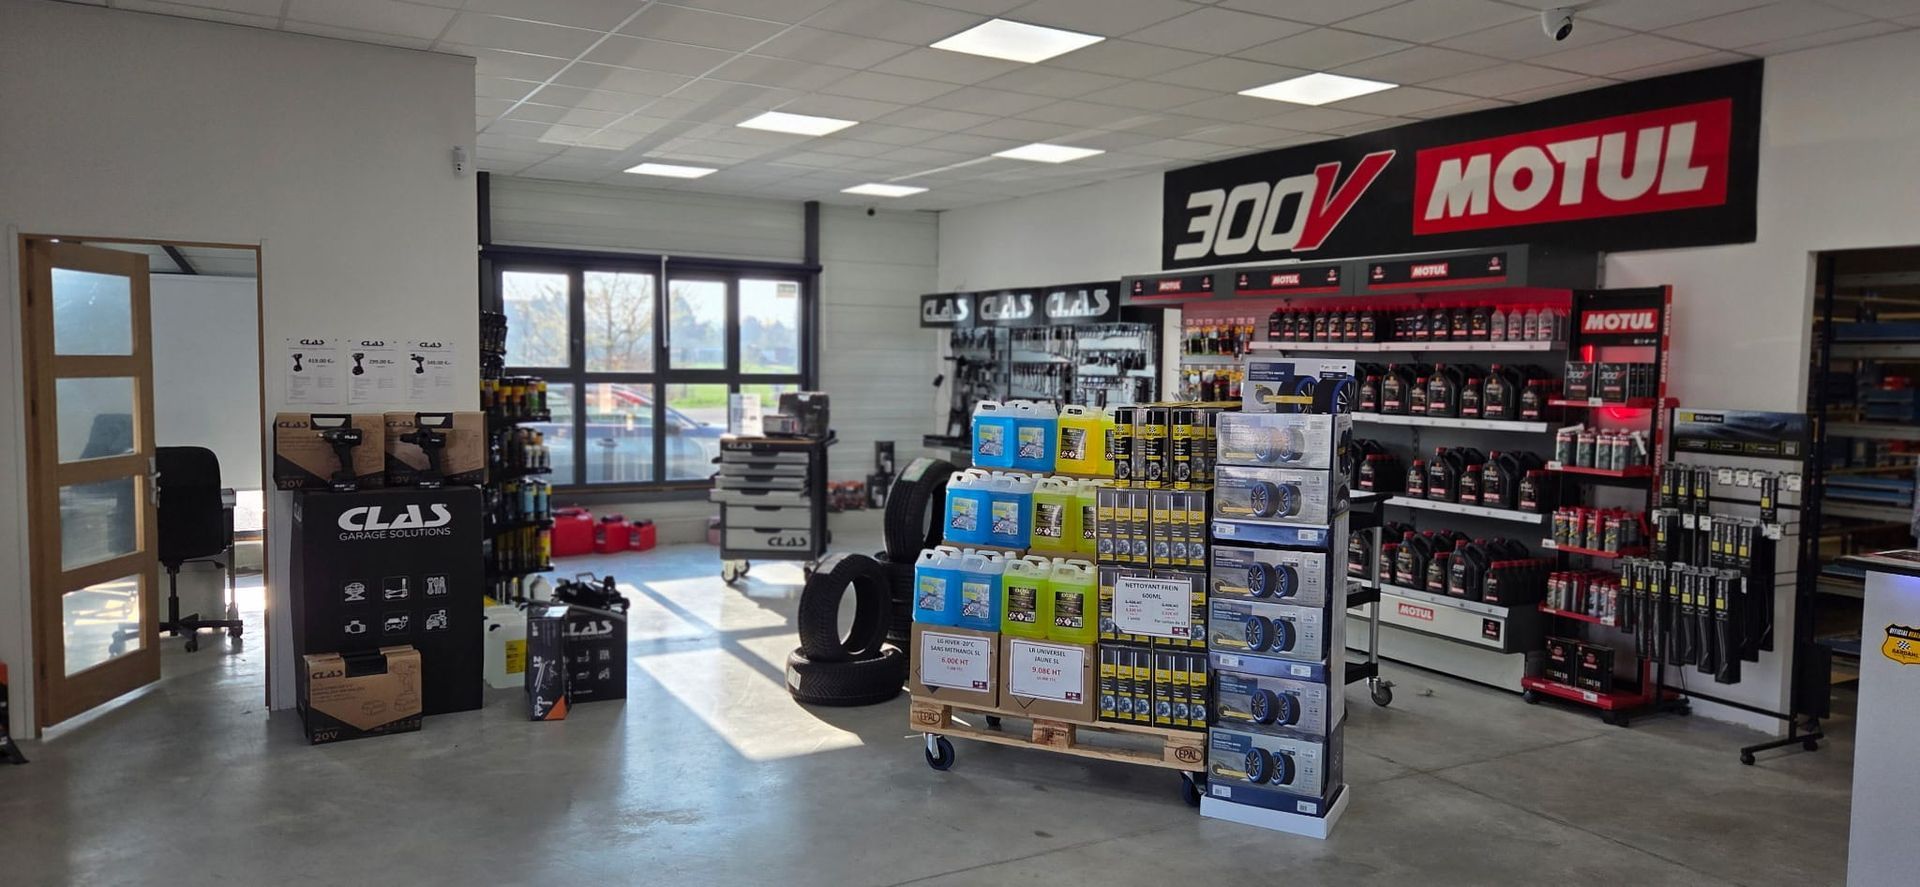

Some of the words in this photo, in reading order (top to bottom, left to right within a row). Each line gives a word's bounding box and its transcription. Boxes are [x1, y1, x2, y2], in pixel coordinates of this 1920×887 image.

[1424, 121, 1709, 221] MOTUL
[1173, 150, 1397, 261] 300V
[1411, 264, 1447, 277] MOTUL
[1272, 274, 1300, 285] MOTUL
[980, 294, 1034, 320] CLAS
[1045, 289, 1110, 318] CLAS
[923, 299, 969, 322] CLAS
[1585, 312, 1655, 330] MOTUL
[337, 503, 452, 531] CLAS
[339, 531, 387, 541] GARAGE
[389, 527, 451, 539] SOLUTIONS
[767, 536, 807, 547] CLAS
[1125, 582, 1160, 590] NETTOYANT
[1161, 584, 1179, 592] FREIN
[1400, 604, 1432, 620] MOTUL
[562, 620, 614, 636] LAS
[1037, 648, 1066, 657] UNIVERSEL
[959, 658, 969, 666] HT
[1034, 656, 1052, 664] JAUNE
[312, 670, 344, 680] CLAS
[1051, 668, 1062, 676] HT
[314, 731, 338, 742] 20V
[1178, 749, 1199, 761] EPAL
